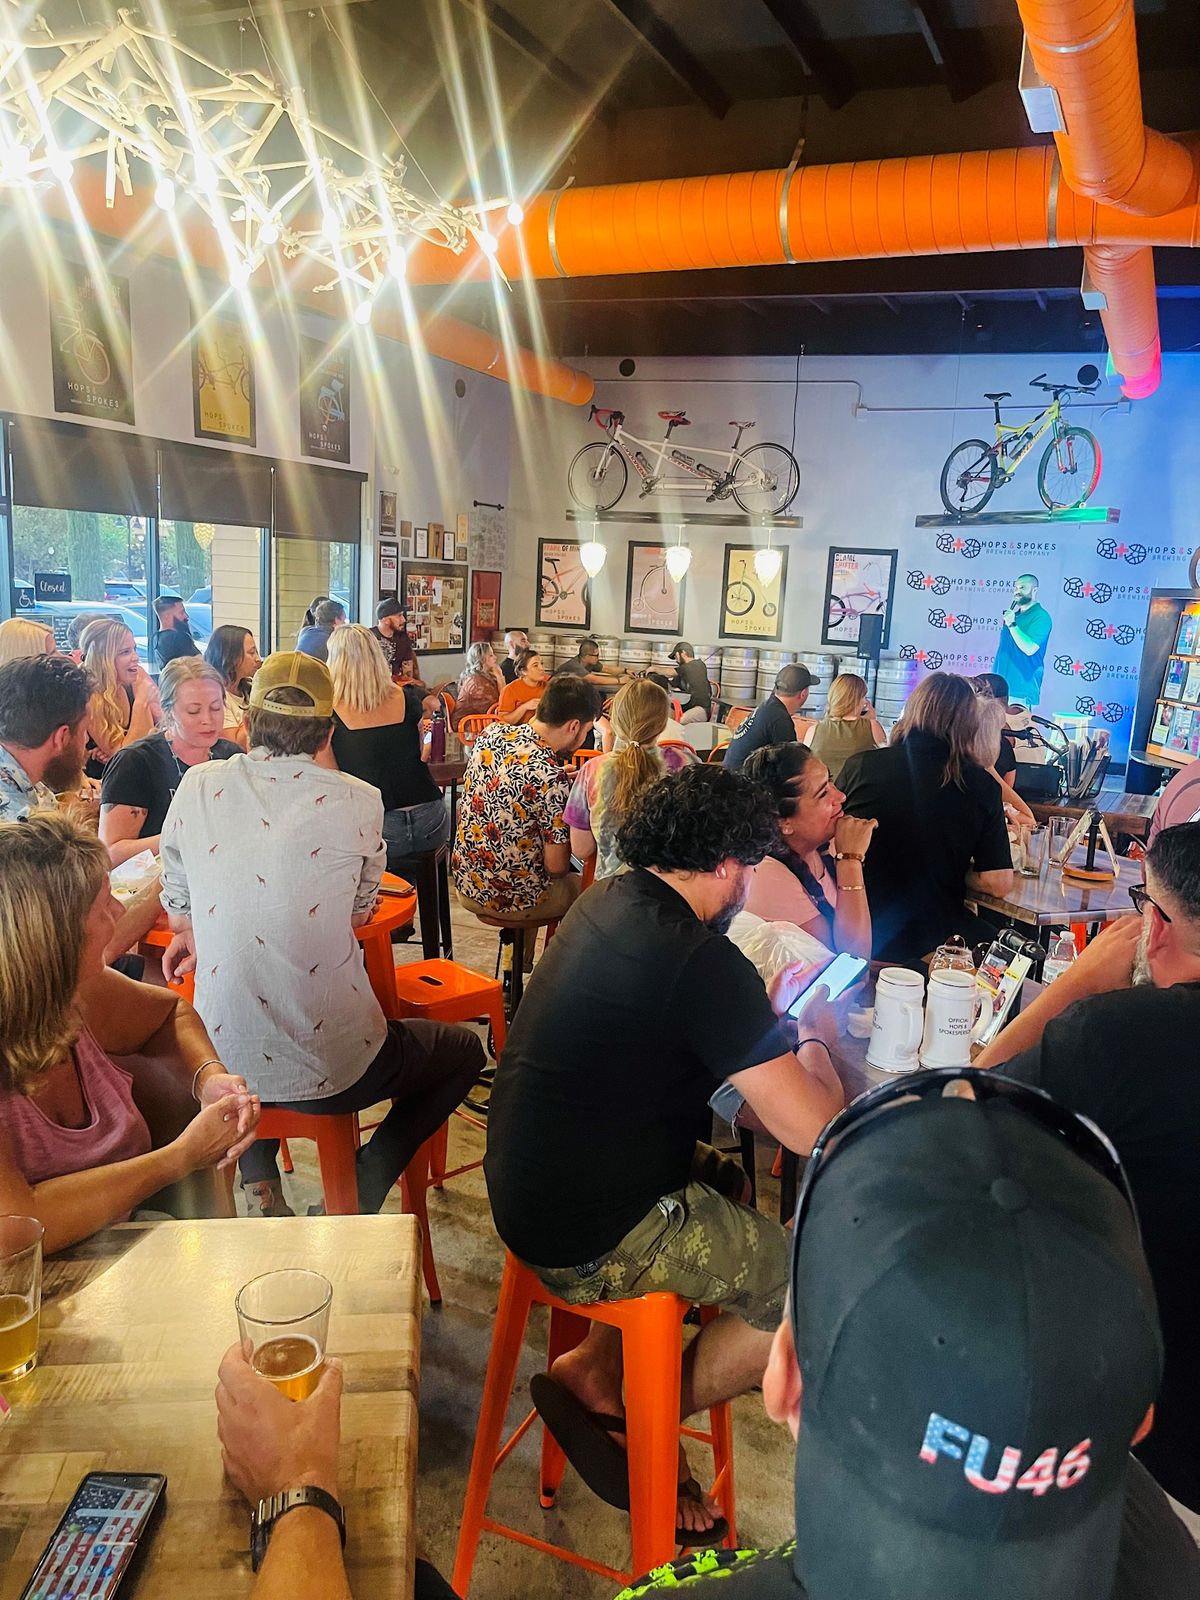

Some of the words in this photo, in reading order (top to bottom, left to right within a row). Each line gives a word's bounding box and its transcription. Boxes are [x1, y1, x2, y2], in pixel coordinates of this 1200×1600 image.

[86, 394, 119, 408] SPOKES
[1016, 542, 1056, 550] SPOKES
[40, 580, 65, 593] Closed
[986, 580, 1016, 588] SPOKE
[1112, 585, 1140, 593] HOPS
[944, 654, 968, 662] HOPS
[1102, 664, 1129, 673] HOPS
[920, 1412, 1092, 1496] FU46
